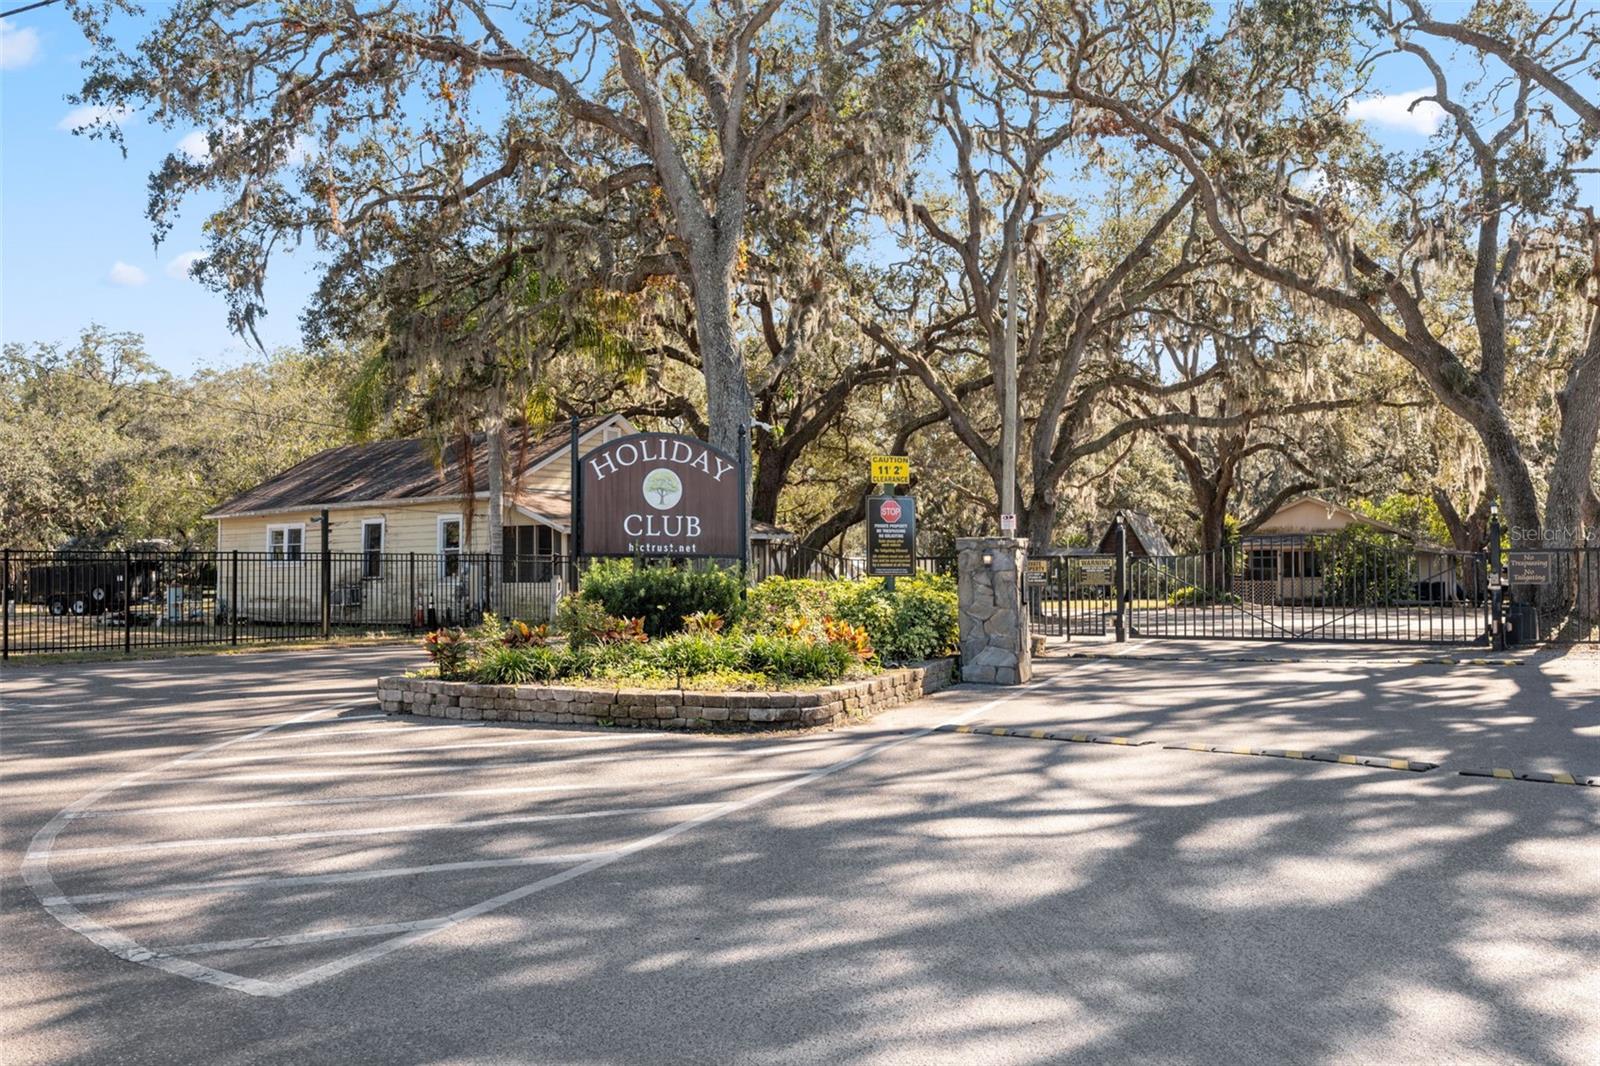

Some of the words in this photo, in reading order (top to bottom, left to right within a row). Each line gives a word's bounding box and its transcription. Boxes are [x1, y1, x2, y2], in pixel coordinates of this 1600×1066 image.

[589, 439, 734, 482] HOLIDAY
[881, 507, 900, 516] STOP
[623, 514, 702, 537] CLUB
